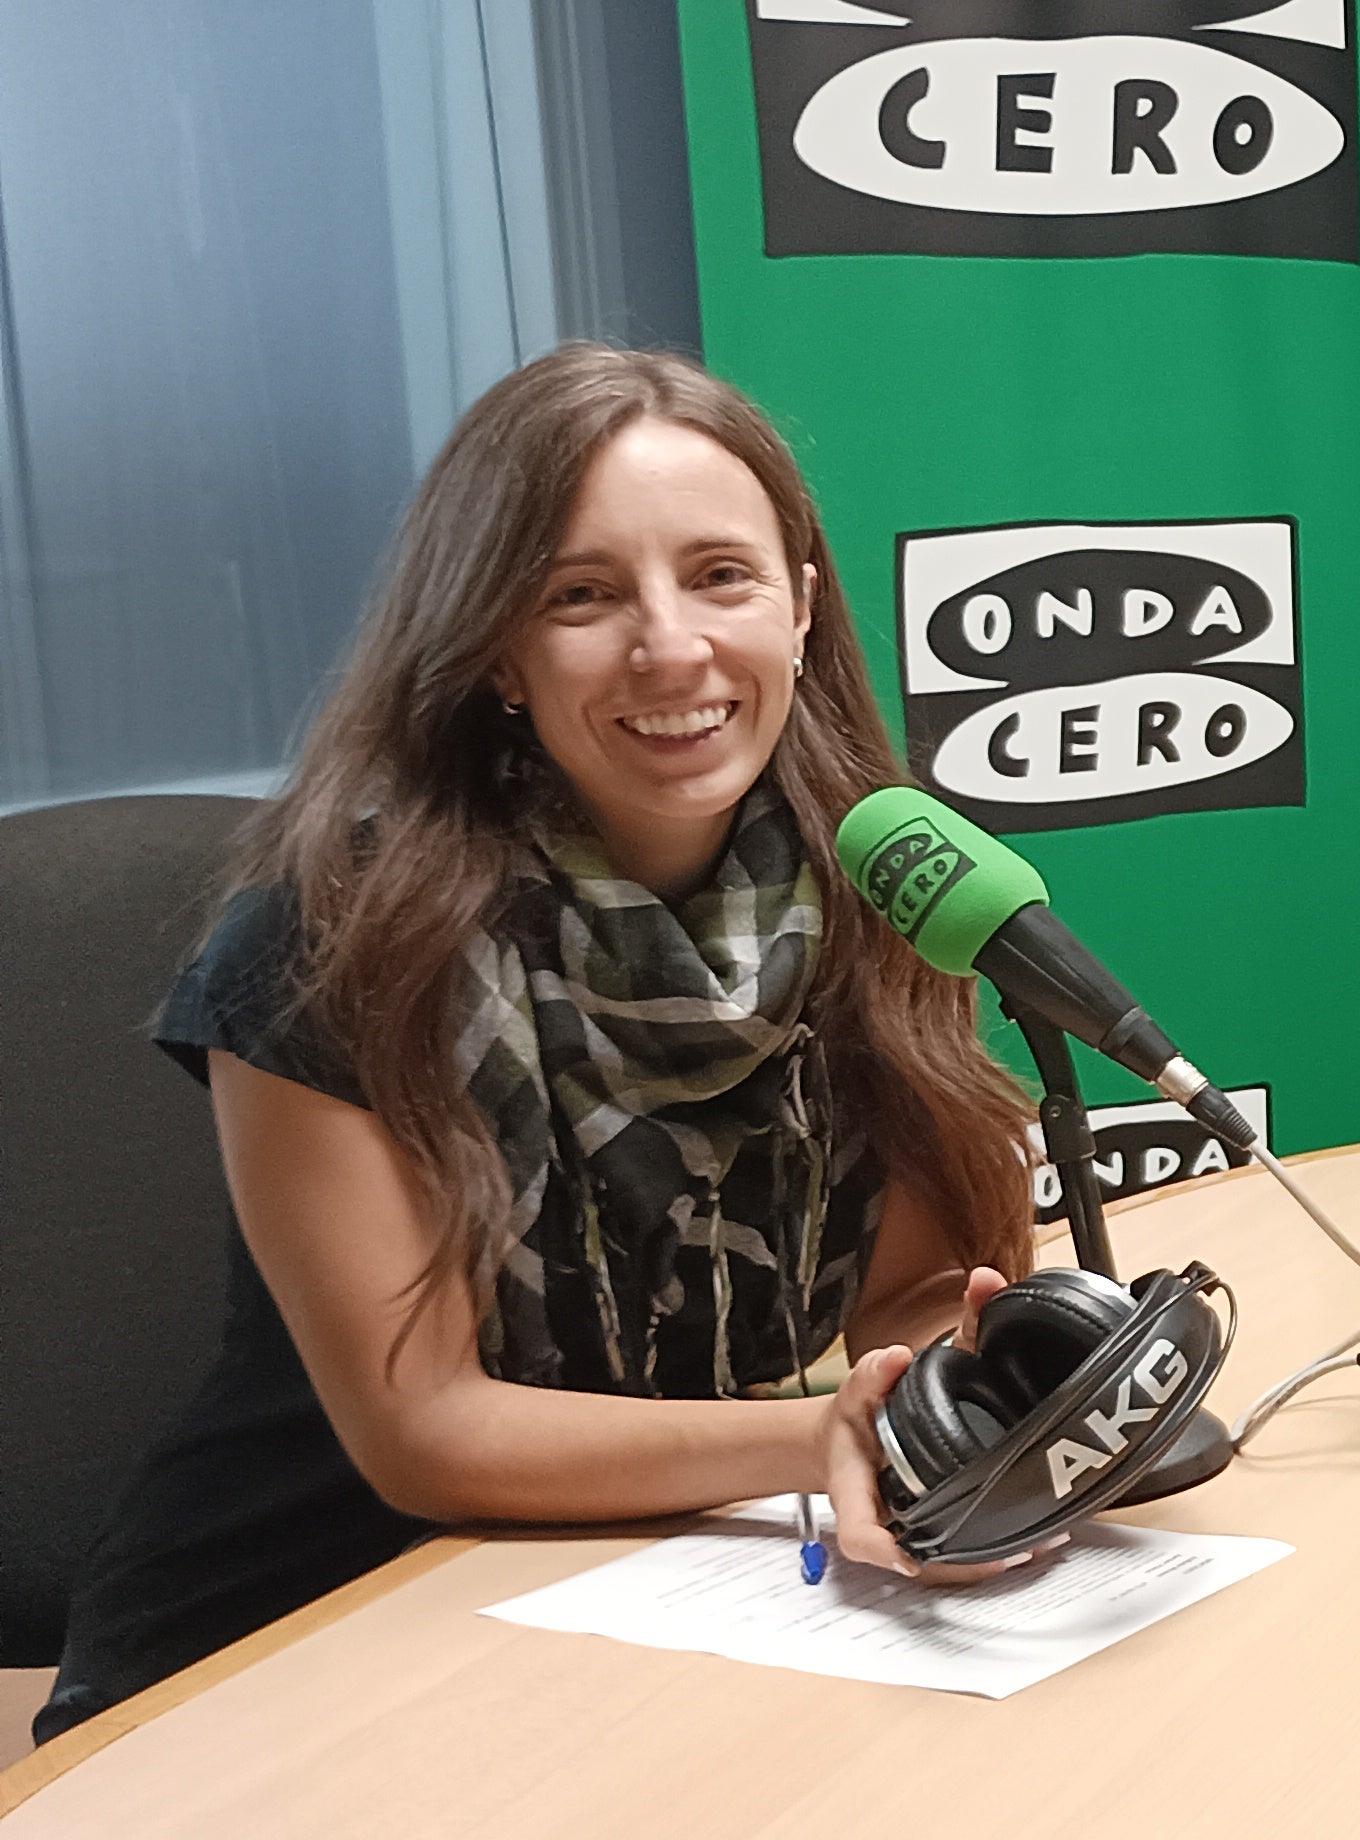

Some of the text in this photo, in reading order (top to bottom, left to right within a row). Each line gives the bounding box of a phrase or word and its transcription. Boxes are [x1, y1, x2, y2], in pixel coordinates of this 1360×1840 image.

[877, 66, 1275, 175] CERO
[961, 584, 1243, 655] ONDA
[987, 700, 1248, 778] CERO
[869, 839, 926, 905] ONDA
[896, 858, 948, 925] CERO
[1046, 1338, 1189, 1500] AKG
